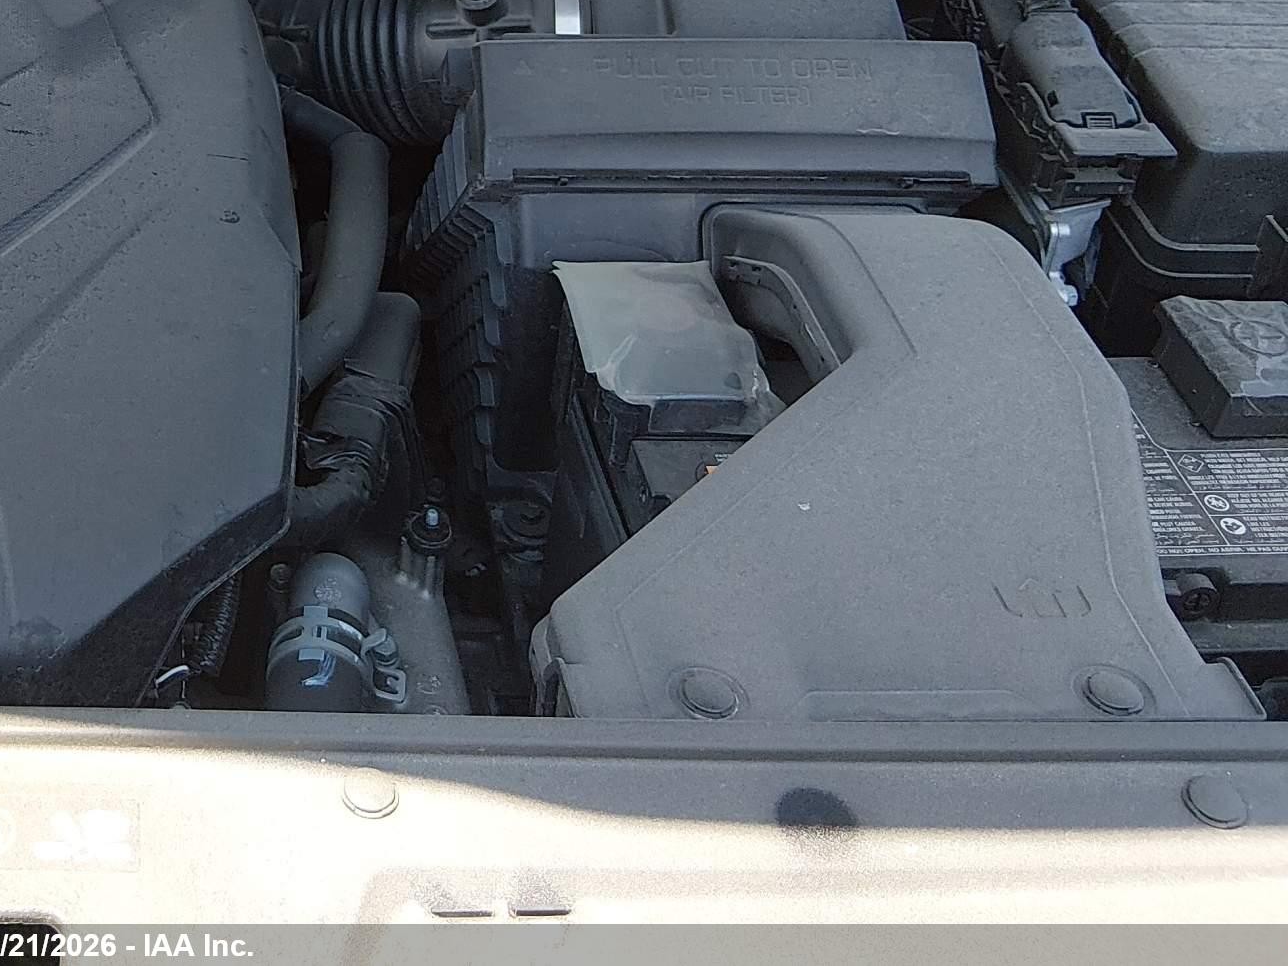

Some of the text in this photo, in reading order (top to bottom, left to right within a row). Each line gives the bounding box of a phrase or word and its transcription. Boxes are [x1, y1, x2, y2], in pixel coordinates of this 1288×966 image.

[592, 57, 873, 82] PULL OUT TO OPEN
